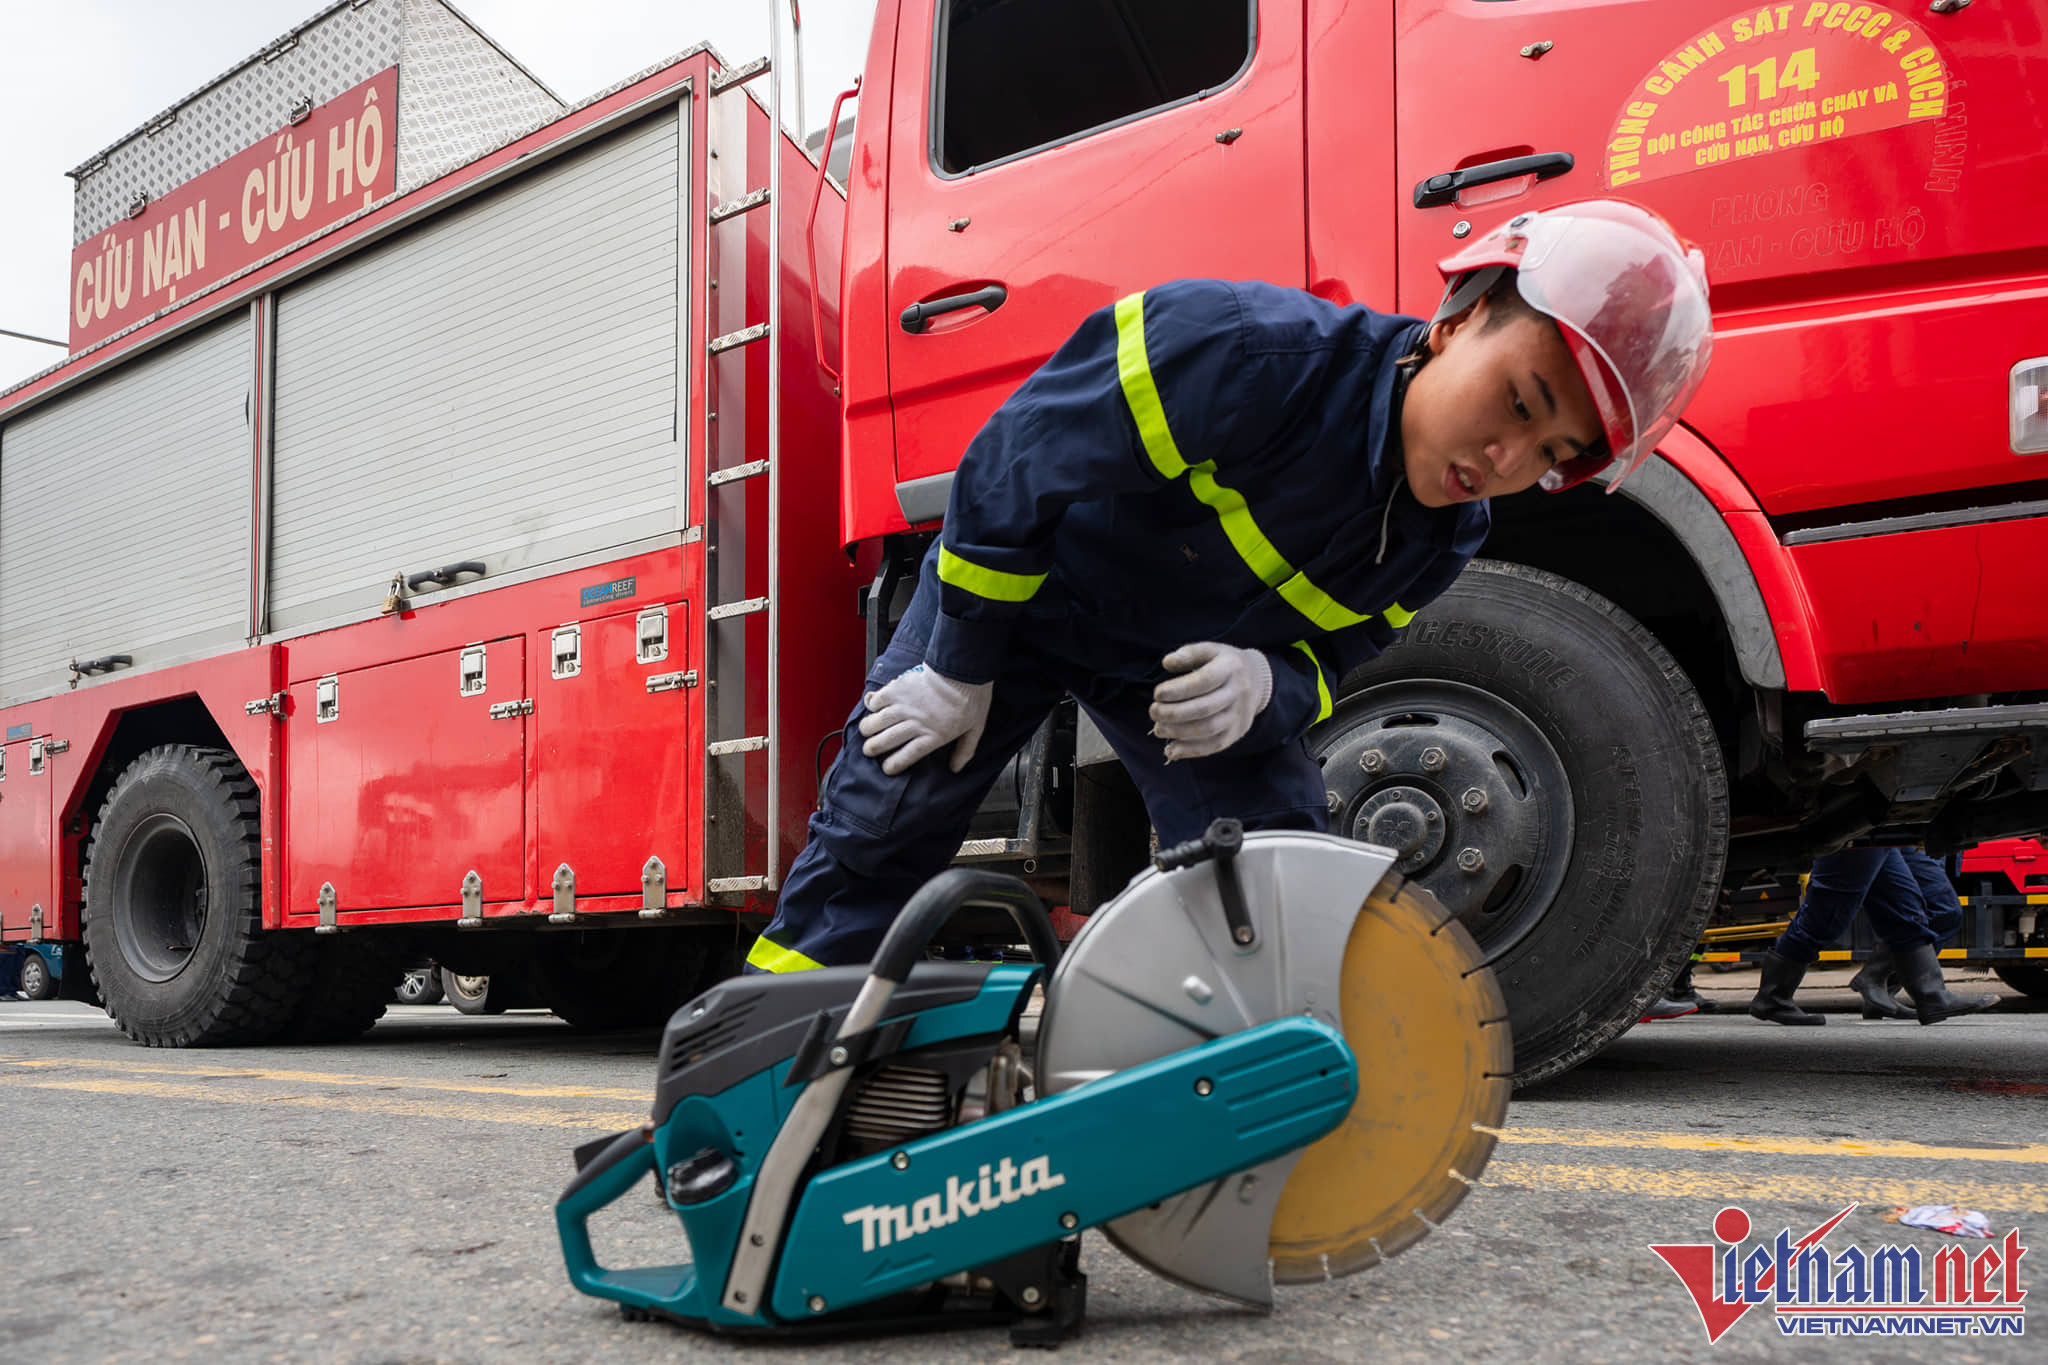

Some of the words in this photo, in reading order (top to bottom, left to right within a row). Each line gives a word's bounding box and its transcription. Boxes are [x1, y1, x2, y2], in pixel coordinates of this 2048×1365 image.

[1608, 99, 1659, 187] PHÒNG
[1645, 32, 1726, 95] CẢNH
[1731, 4, 1794, 43] SÁT
[1802, 1, 1892, 39] PCCC
[1882, 28, 1911, 54] &
[1899, 46, 1946, 118] CNCH
[1718, 47, 1821, 107] 114
[1680, 122, 1726, 147] CÔNG
[1730, 113, 1764, 135] TÁC
[1821, 88, 1869, 115] CHÁY
[1873, 82, 1898, 104] VÀ
[1695, 142, 1730, 166] CỨU
[1778, 123, 1814, 147] CỨU
[1820, 115, 1844, 138] HỘ
[75, 233, 134, 329] CỨU
[142, 199, 206, 303] NẠN
[241, 133, 316, 244] CỨU
[328, 86, 383, 208] HỘ
[582, 579, 633, 600] OCEANREEF
[842, 1155, 1066, 1252] makita
